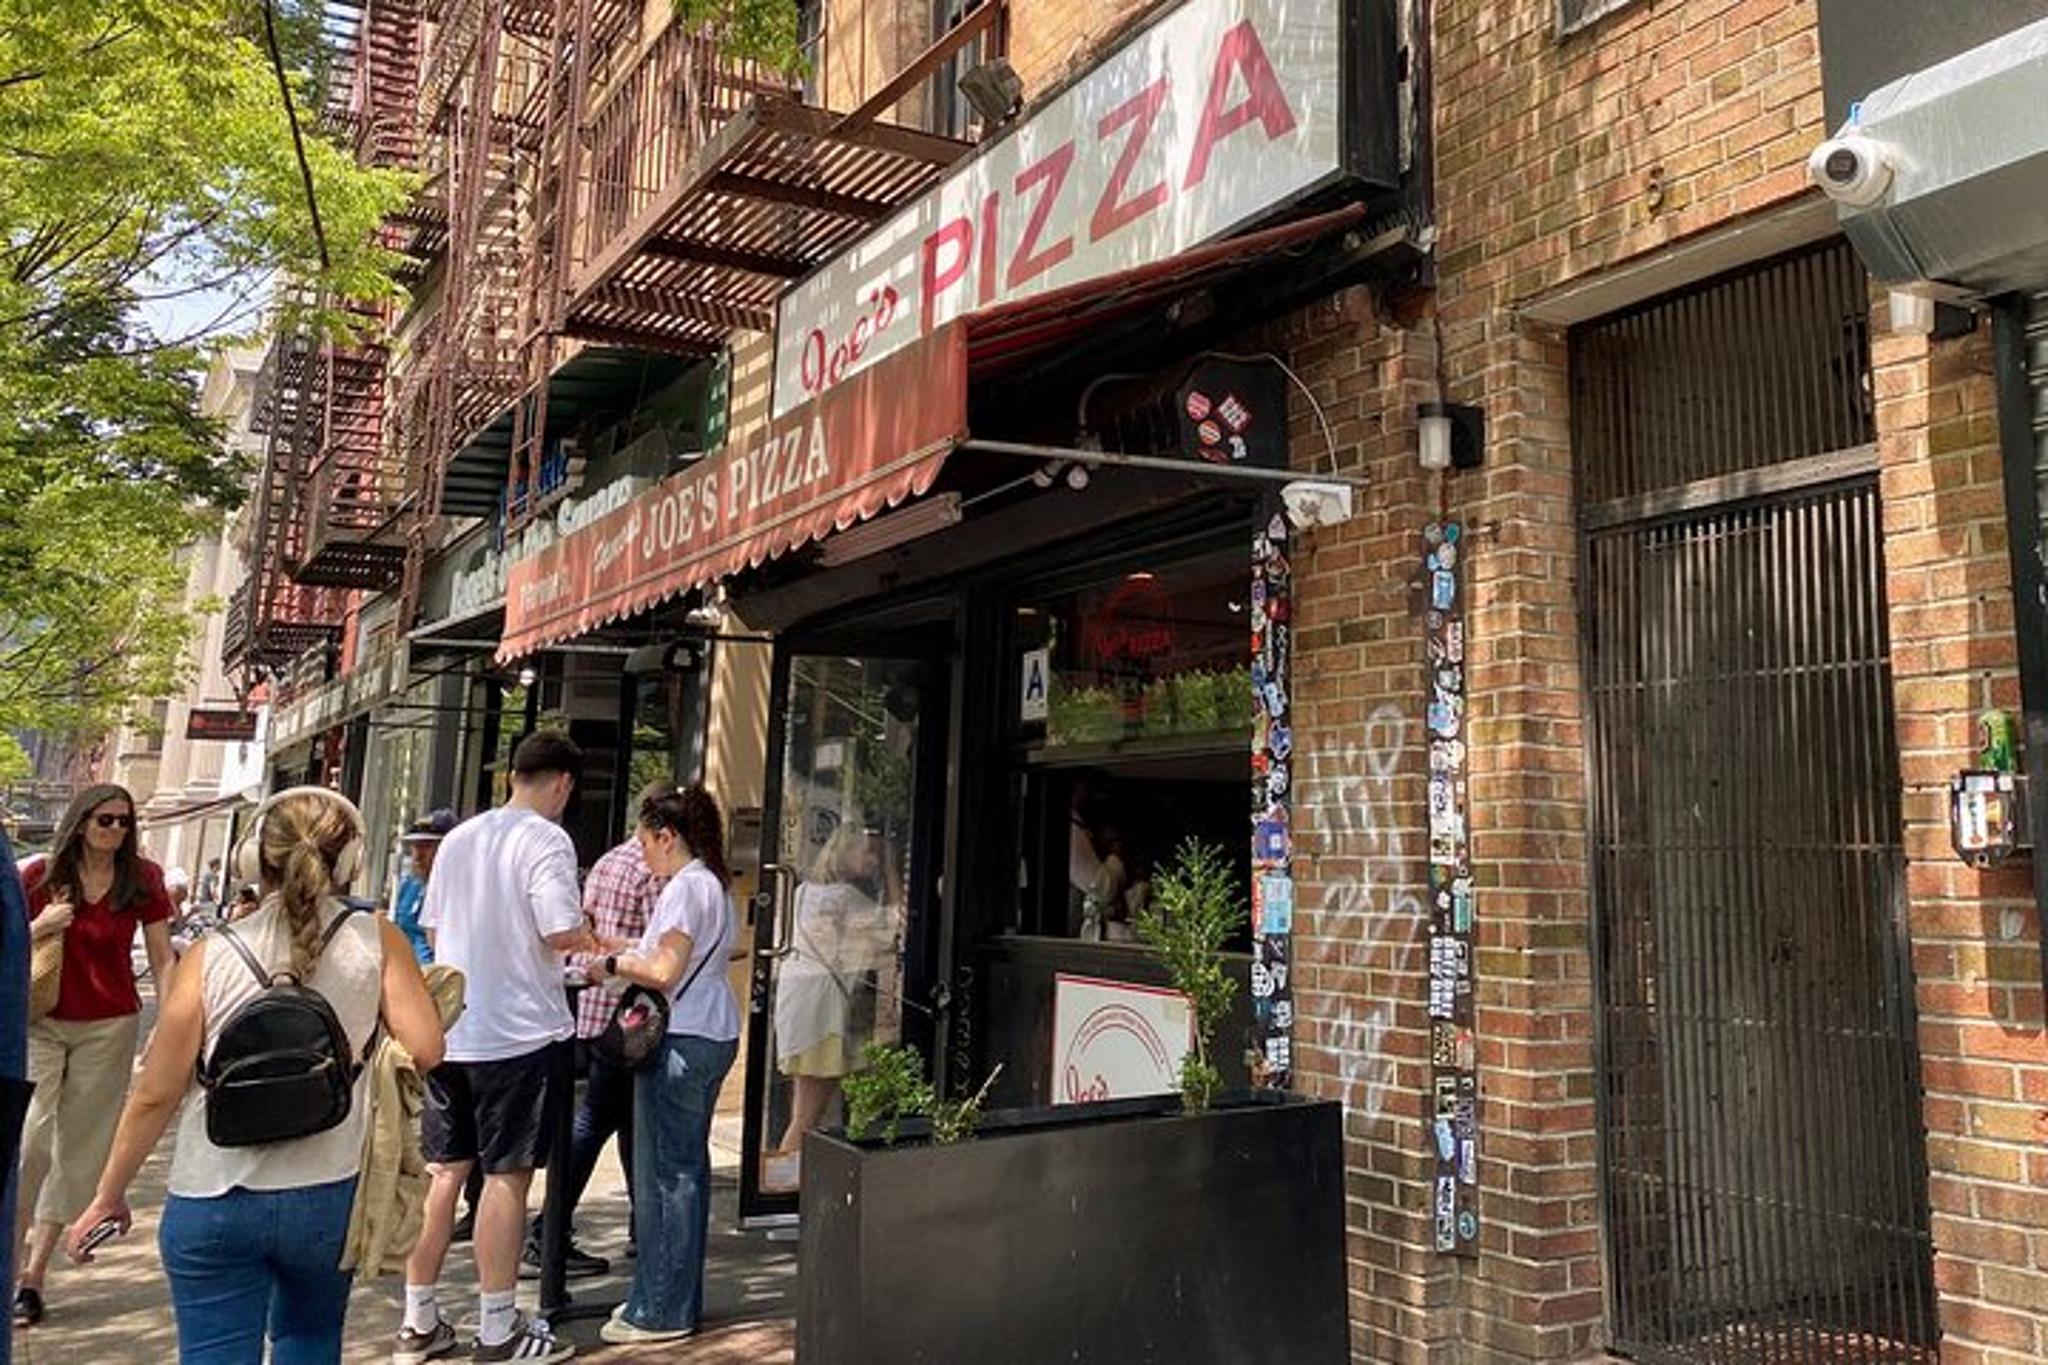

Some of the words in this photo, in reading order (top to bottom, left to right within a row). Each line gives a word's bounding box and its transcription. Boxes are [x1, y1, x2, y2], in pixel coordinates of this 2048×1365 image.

[801, 285, 898, 392] Joe's
[921, 18, 1298, 337] PIZZA
[642, 473, 719, 559] JOE'S
[727, 416, 829, 520] PIZZA
[1026, 659, 1044, 701] A
